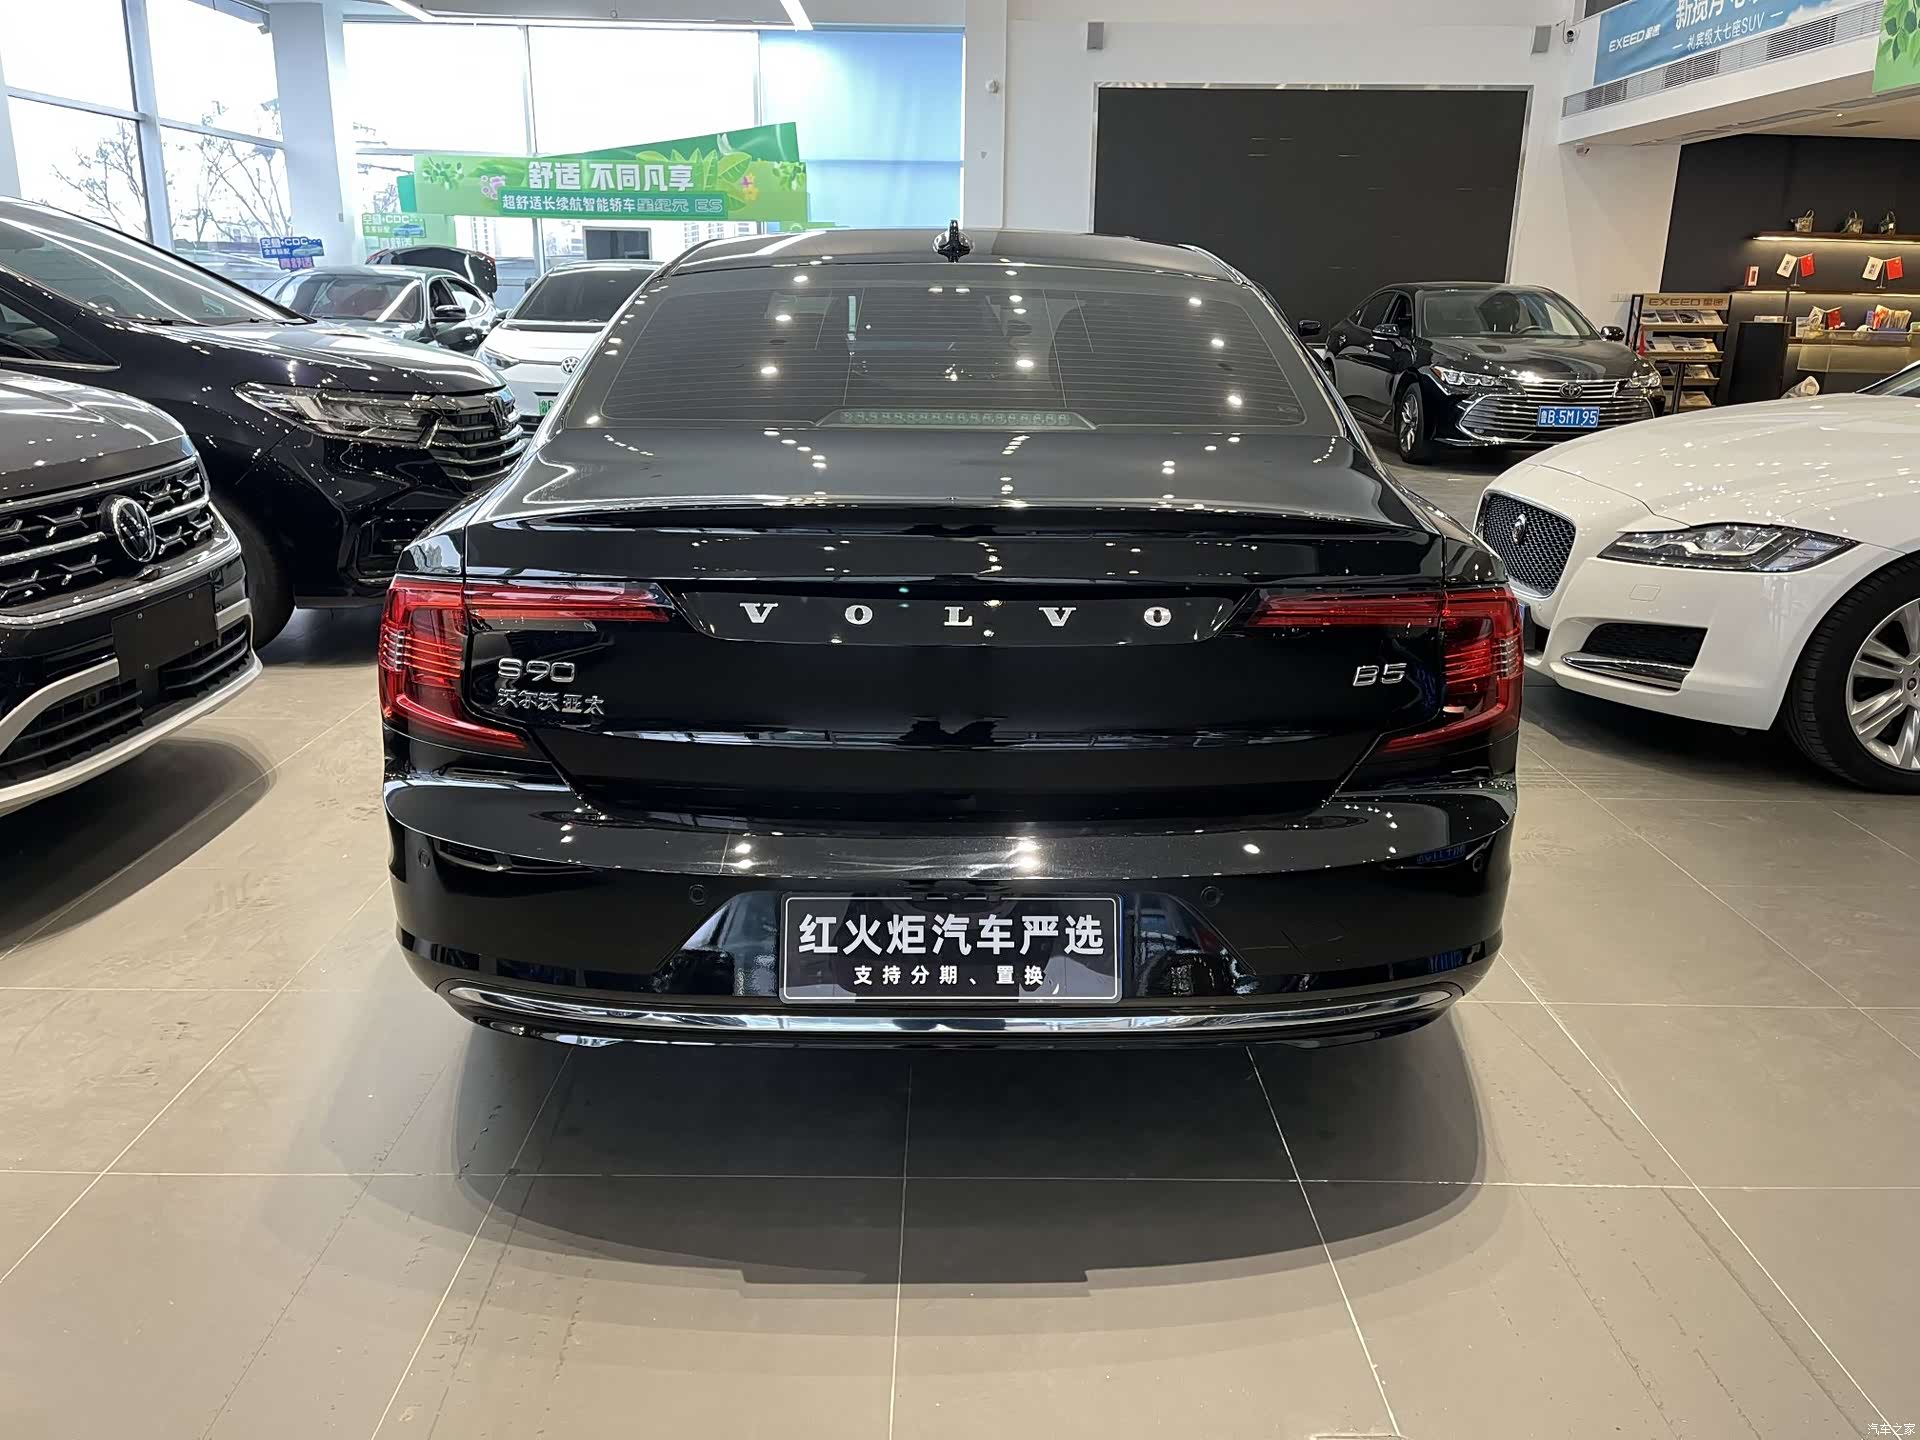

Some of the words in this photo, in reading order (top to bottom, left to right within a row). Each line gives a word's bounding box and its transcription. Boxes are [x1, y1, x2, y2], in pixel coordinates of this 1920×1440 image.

[528, 161, 581, 190] 舒适
[590, 163, 694, 191] 不同凡享
[1648, 297, 1701, 307] EXEED
[739, 602, 1172, 627] VOLVO
[498, 657, 575, 683] S90
[1352, 662, 1407, 687] B5
[497, 688, 605, 715] 沃尔沃亚太
[798, 913, 1105, 956] 红火炬汽车严选
[853, 964, 1044, 986] 支持分期、置换
